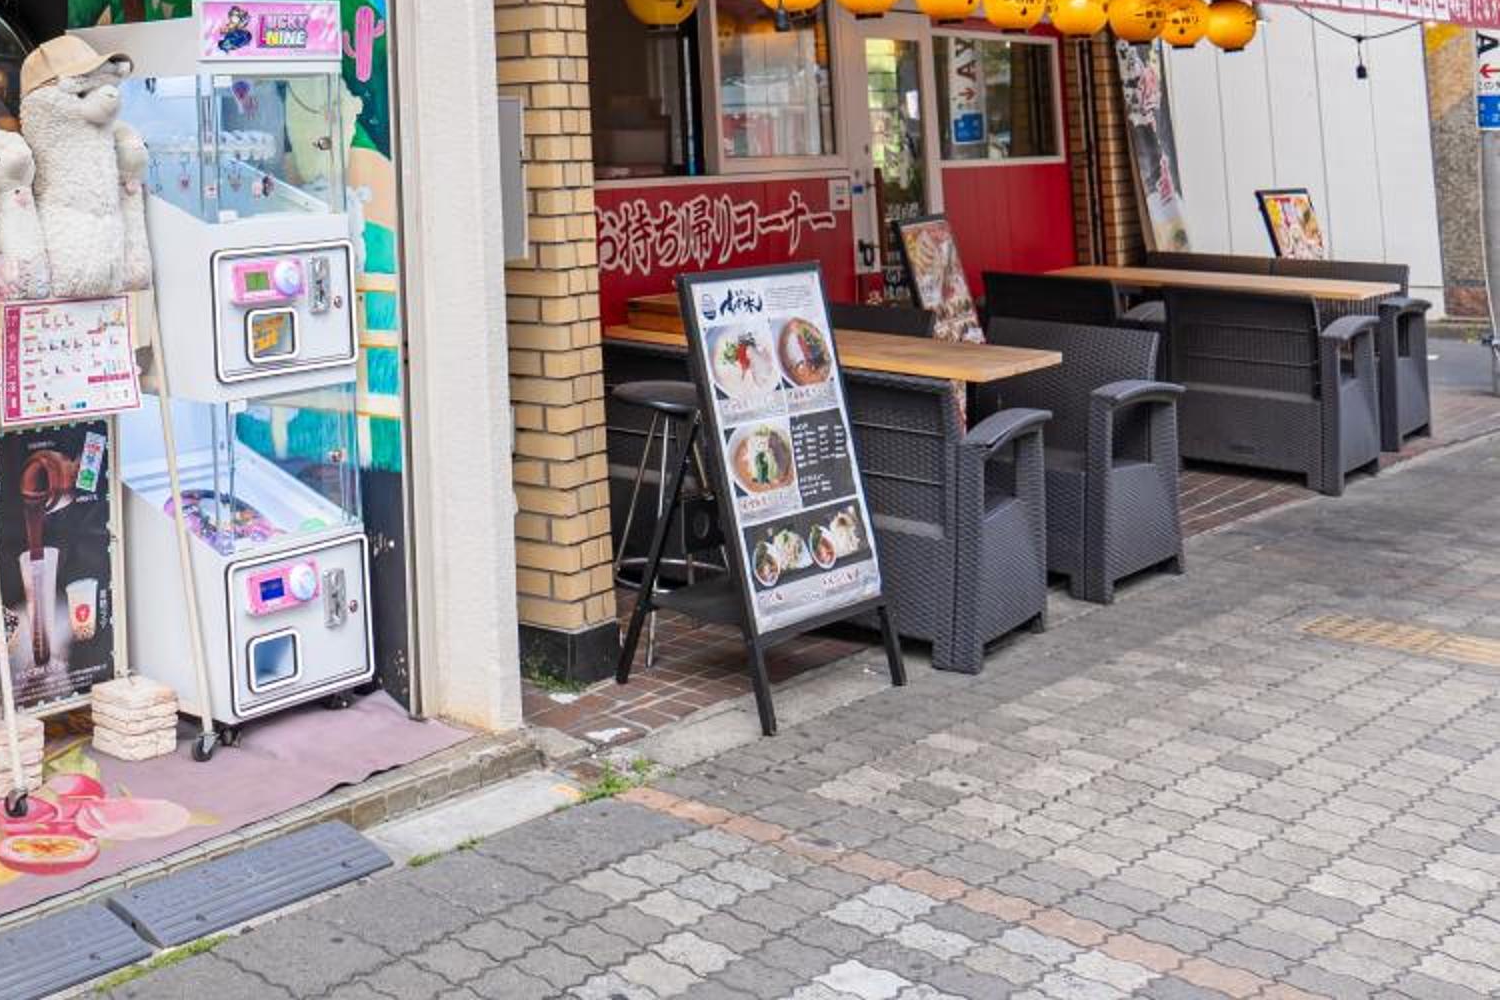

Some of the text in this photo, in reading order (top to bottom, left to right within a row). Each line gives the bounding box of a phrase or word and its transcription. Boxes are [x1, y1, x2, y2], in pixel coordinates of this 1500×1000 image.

[595, 191, 836, 277] お持ち帰りコーナー
